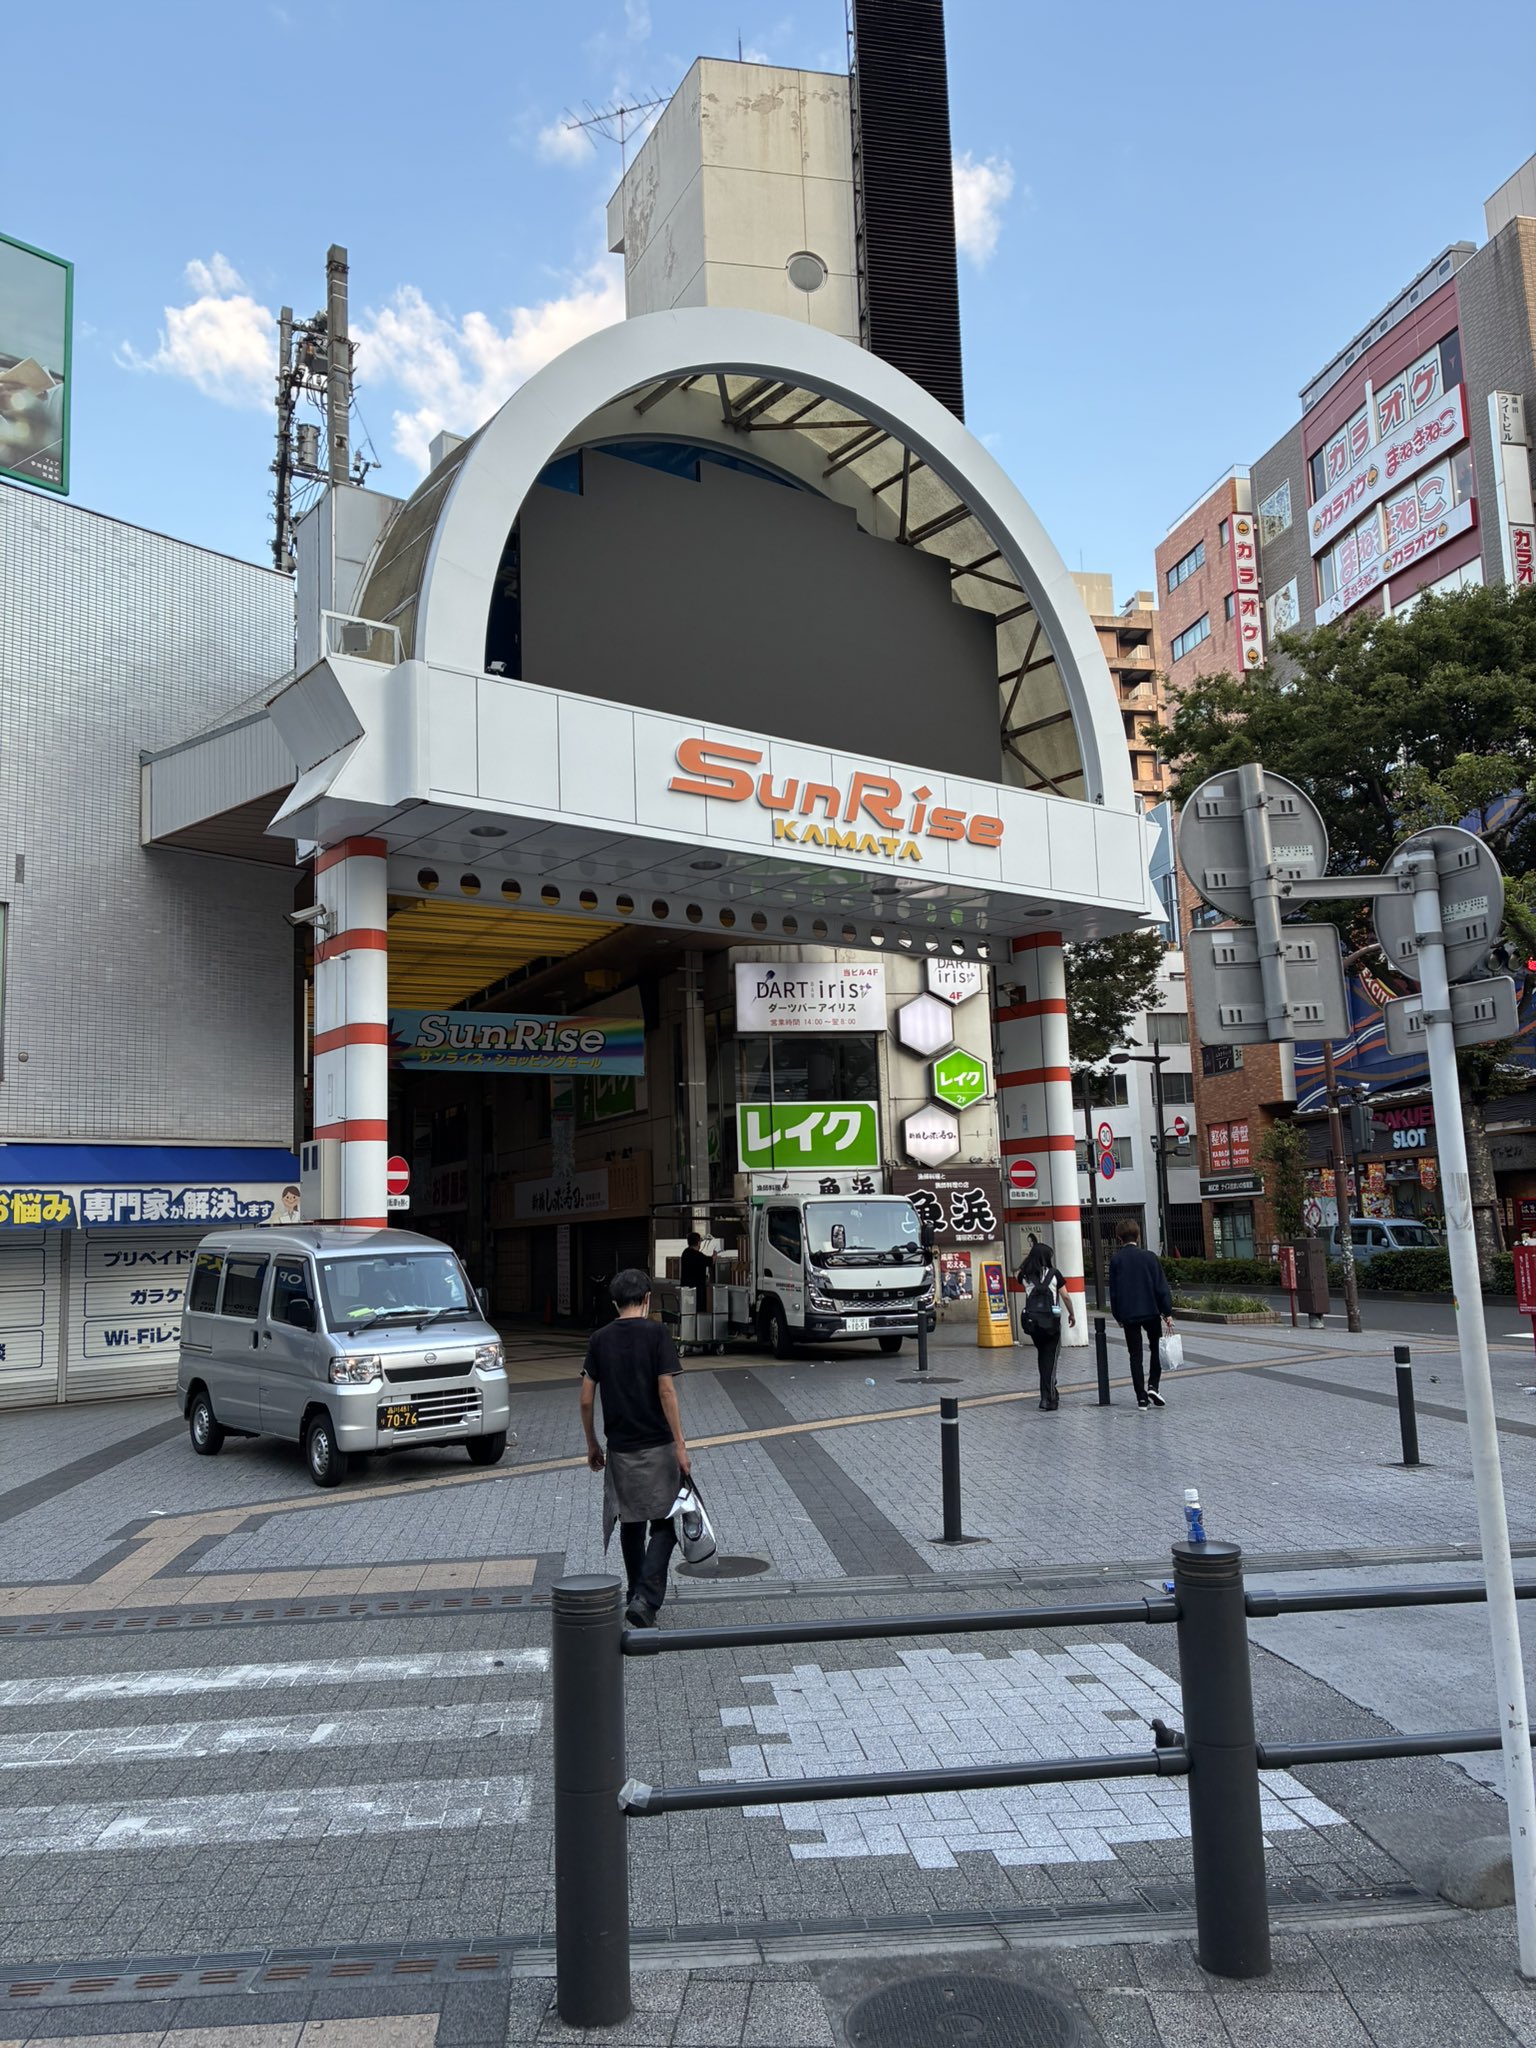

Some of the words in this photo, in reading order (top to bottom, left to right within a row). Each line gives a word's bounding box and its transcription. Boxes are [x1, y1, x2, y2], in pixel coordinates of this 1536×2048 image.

[1329, 364, 1437, 482] カラオケ
[1501, 396, 1512, 441] ライトビル
[1321, 473, 1367, 527] カラオケ
[1386, 409, 1455, 478] まねきねこ
[1392, 528, 1437, 567] カラオケ
[1515, 530, 1534, 591] カラオ
[1237, 543, 1259, 640] カラオケ
[668, 737, 1004, 847] SunRise
[773, 818, 922, 861] KAMATA
[756, 982, 808, 998] DART
[819, 980, 859, 998] iris
[938, 970, 966, 983] iris
[768, 1003, 856, 1012] ダーツバーアイリス
[949, 992, 963, 1000] 4F
[416, 1015, 606, 1053] SunRise
[940, 1072, 980, 1086] レイク
[747, 1111, 861, 1151] レイク
[1102, 1130, 1110, 1143] 30
[1393, 1128, 1427, 1149] SLOT
[84, 1191, 272, 1222] 専門家が解決します
[130, 1288, 185, 1305] ガラケ
[853, 1290, 905, 1299] FUSO
[387, 1412, 417, 1428] 70-76
